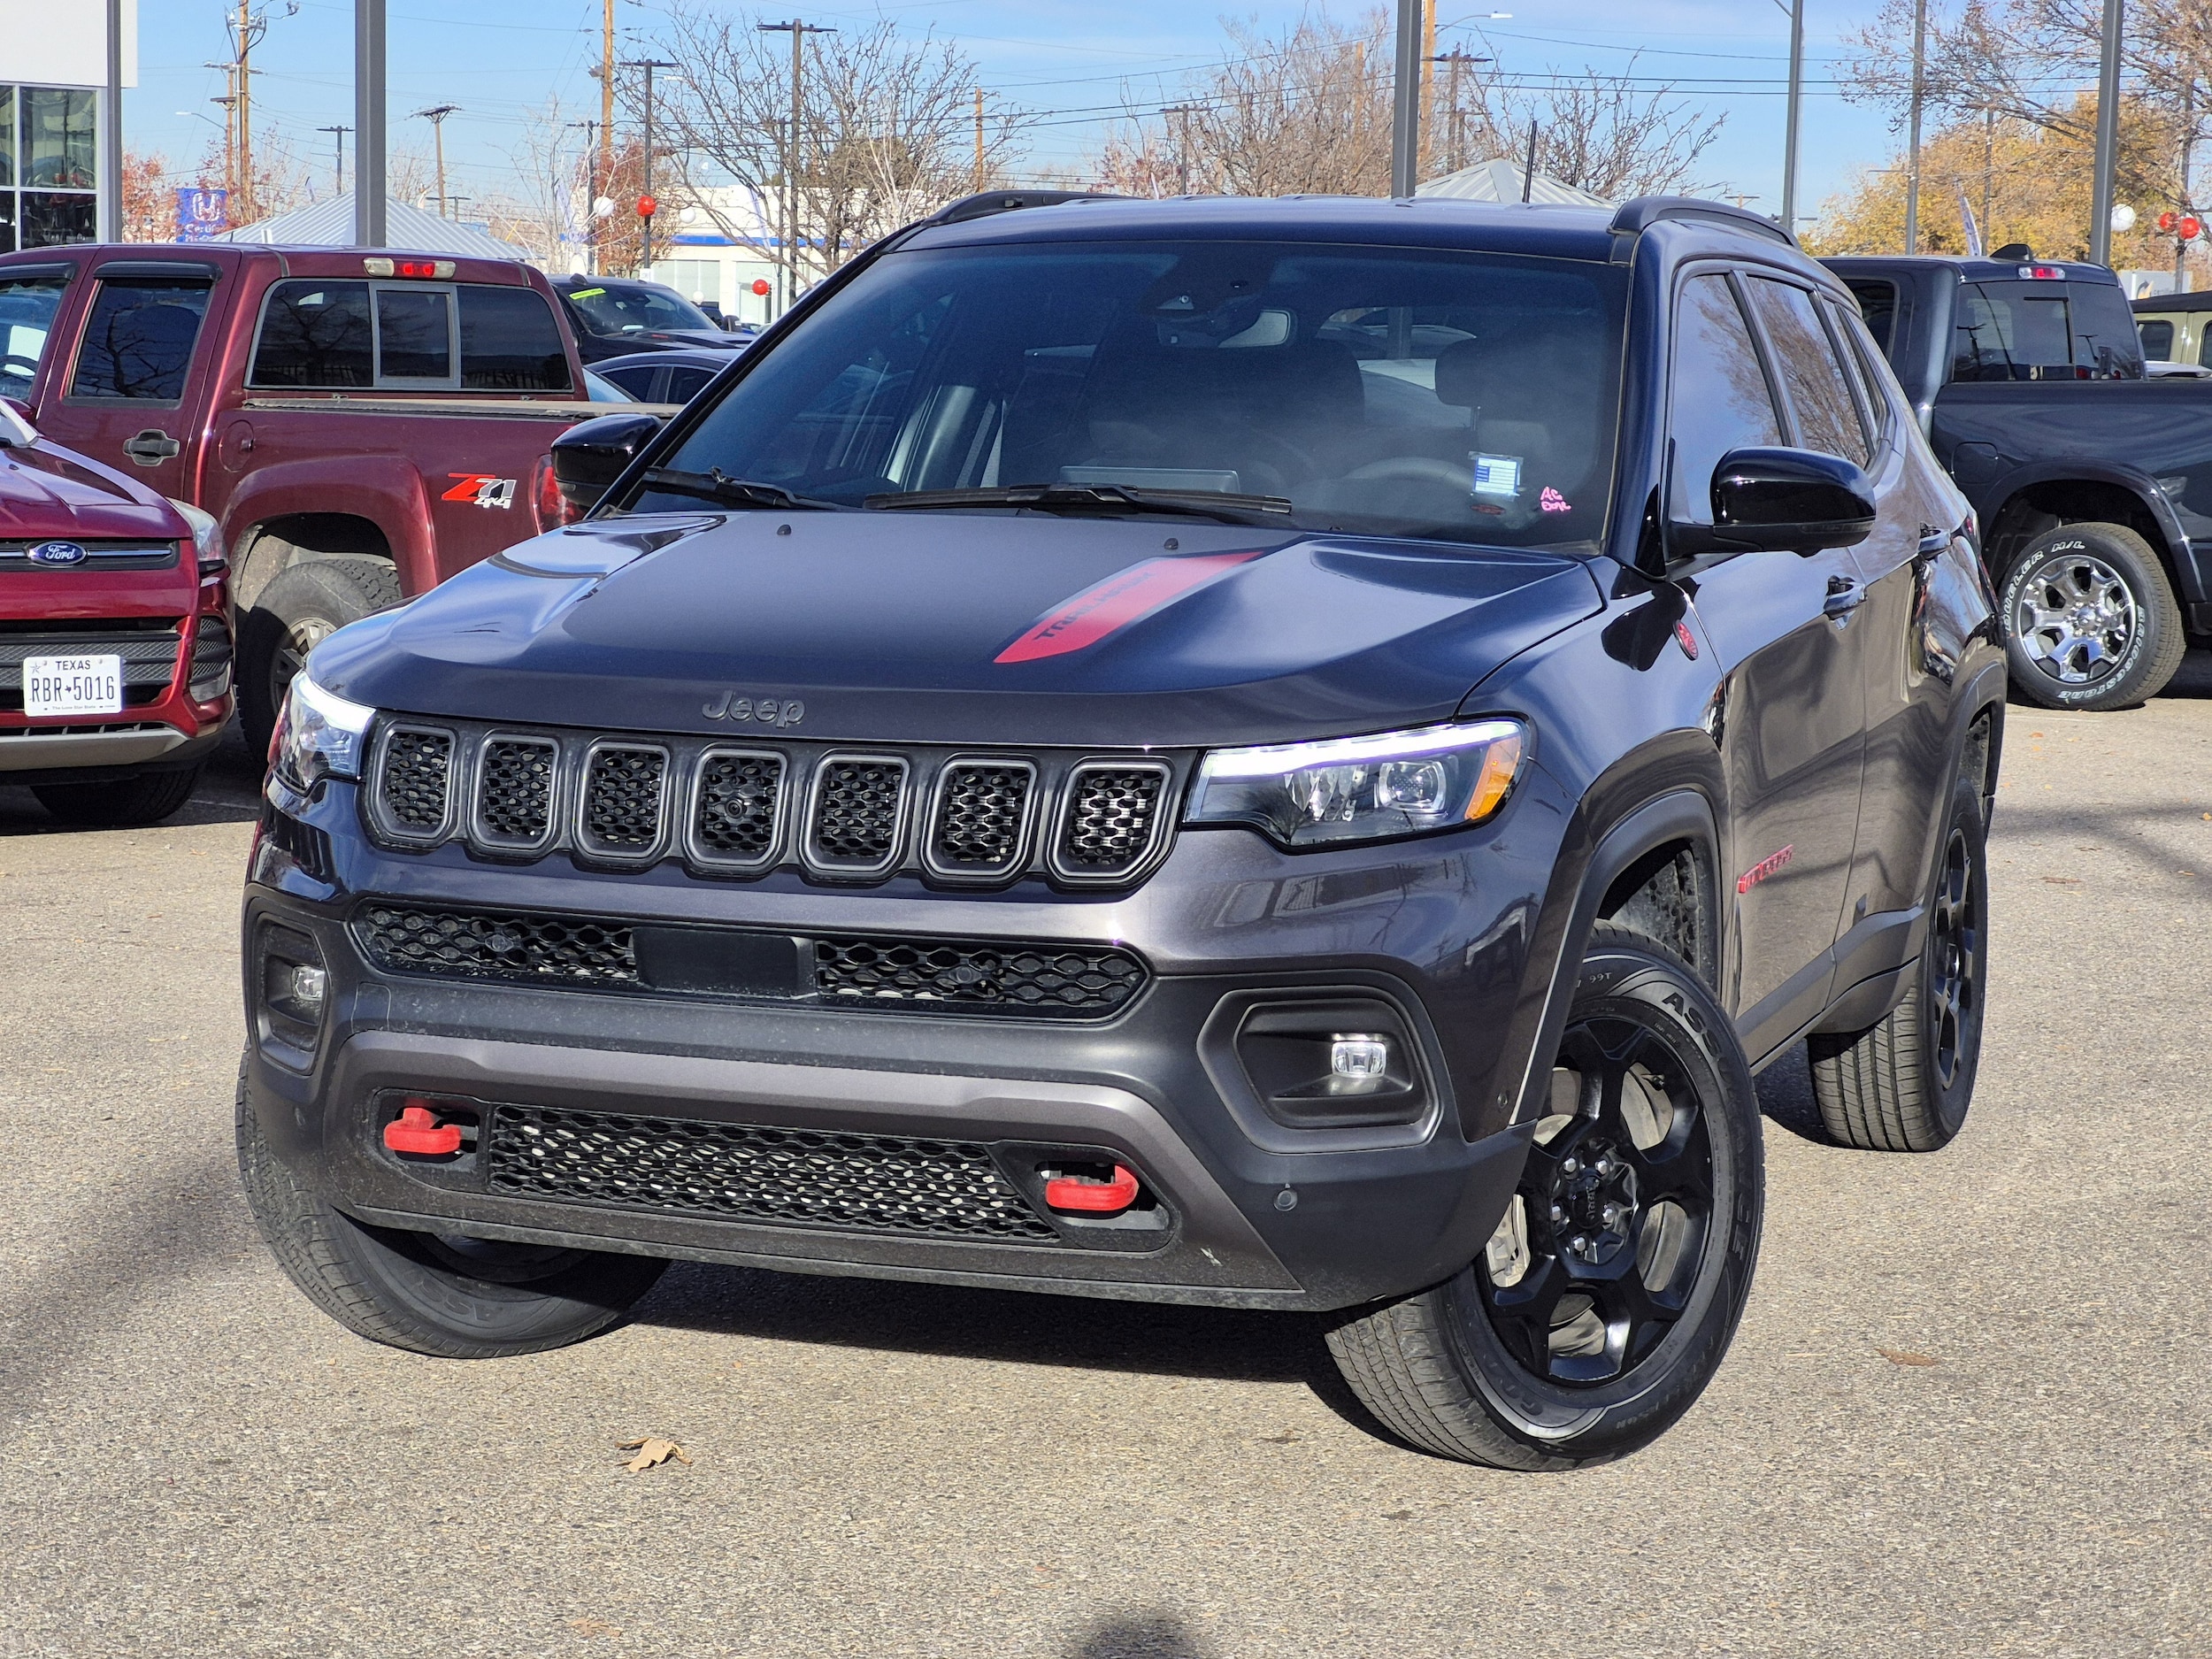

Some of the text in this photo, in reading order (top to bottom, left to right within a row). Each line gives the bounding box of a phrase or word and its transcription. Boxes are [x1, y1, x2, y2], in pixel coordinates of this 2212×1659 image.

[442, 472, 517, 502] Z71
[473, 496, 511, 509] 4x4
[45, 544, 75, 559] Ford
[2002, 549, 2045, 632] DUELER
[55, 659, 91, 672] TEXAS
[702, 689, 806, 729] Jeep
[1589, 972, 1612, 984] 99T
